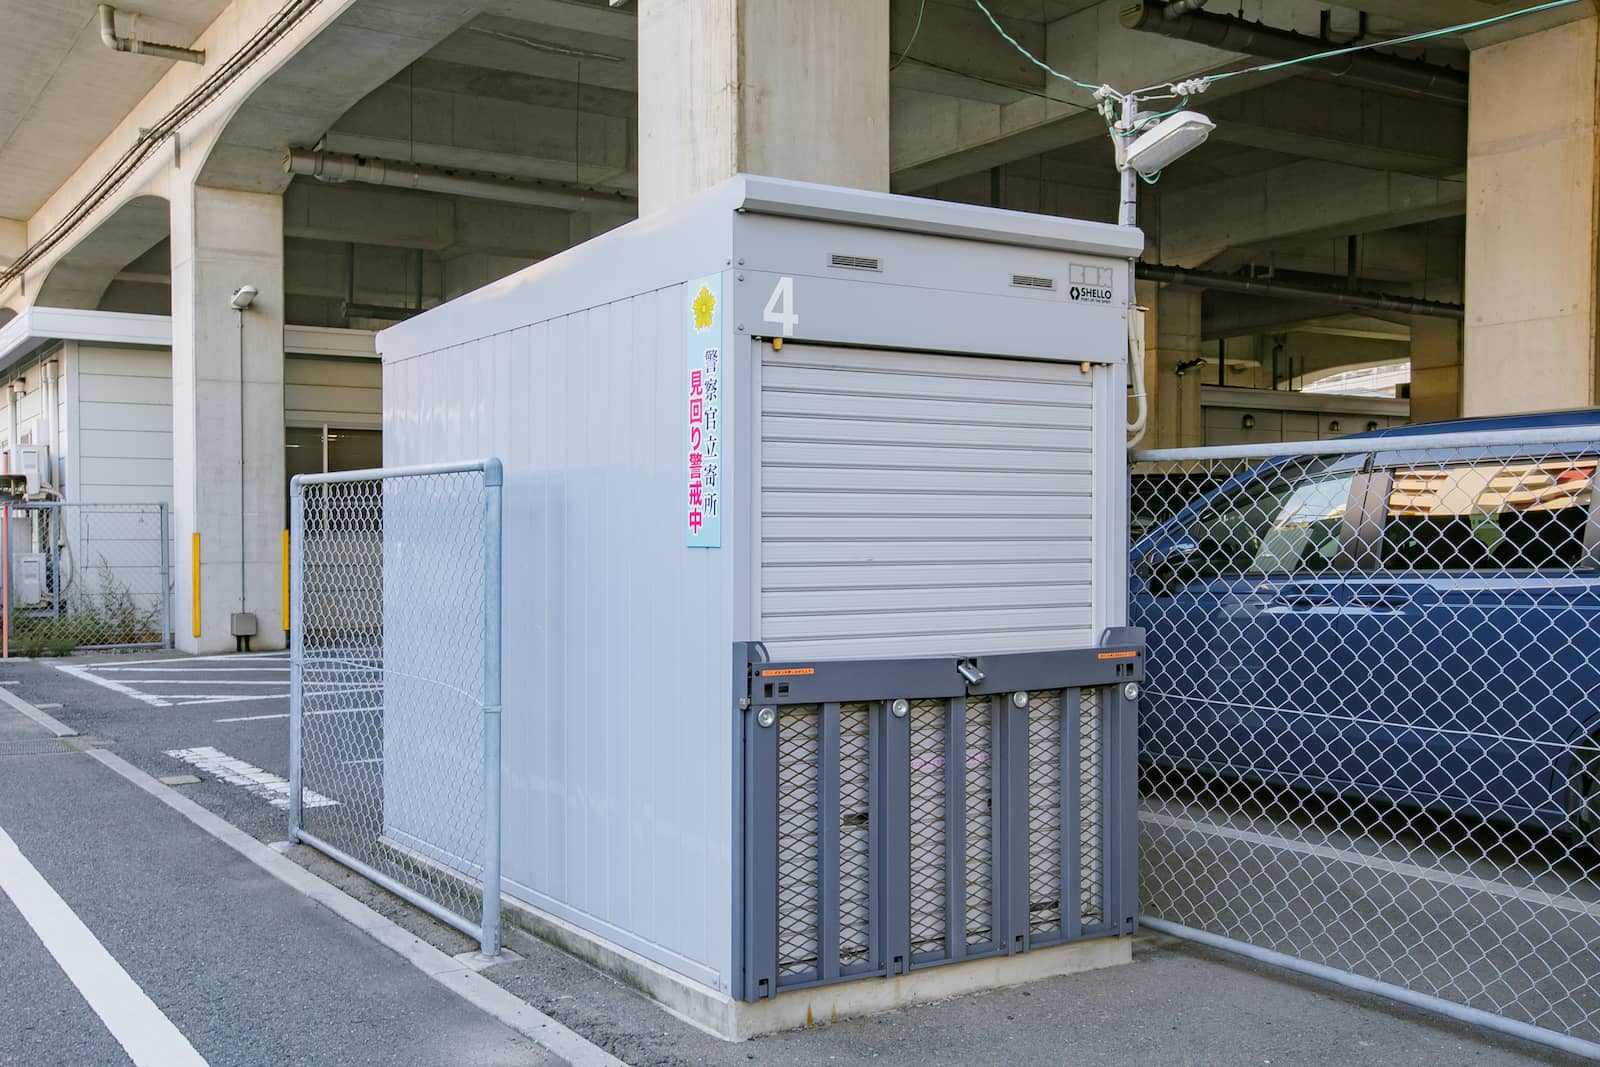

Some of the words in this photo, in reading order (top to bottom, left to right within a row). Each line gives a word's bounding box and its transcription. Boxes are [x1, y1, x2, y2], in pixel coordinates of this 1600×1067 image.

[763, 276, 799, 336] 4
[1081, 287, 1112, 299] SHELLO
[689, 369, 703, 534] 見回り警戒中
[704, 349, 718, 516] 警察官立寄所
